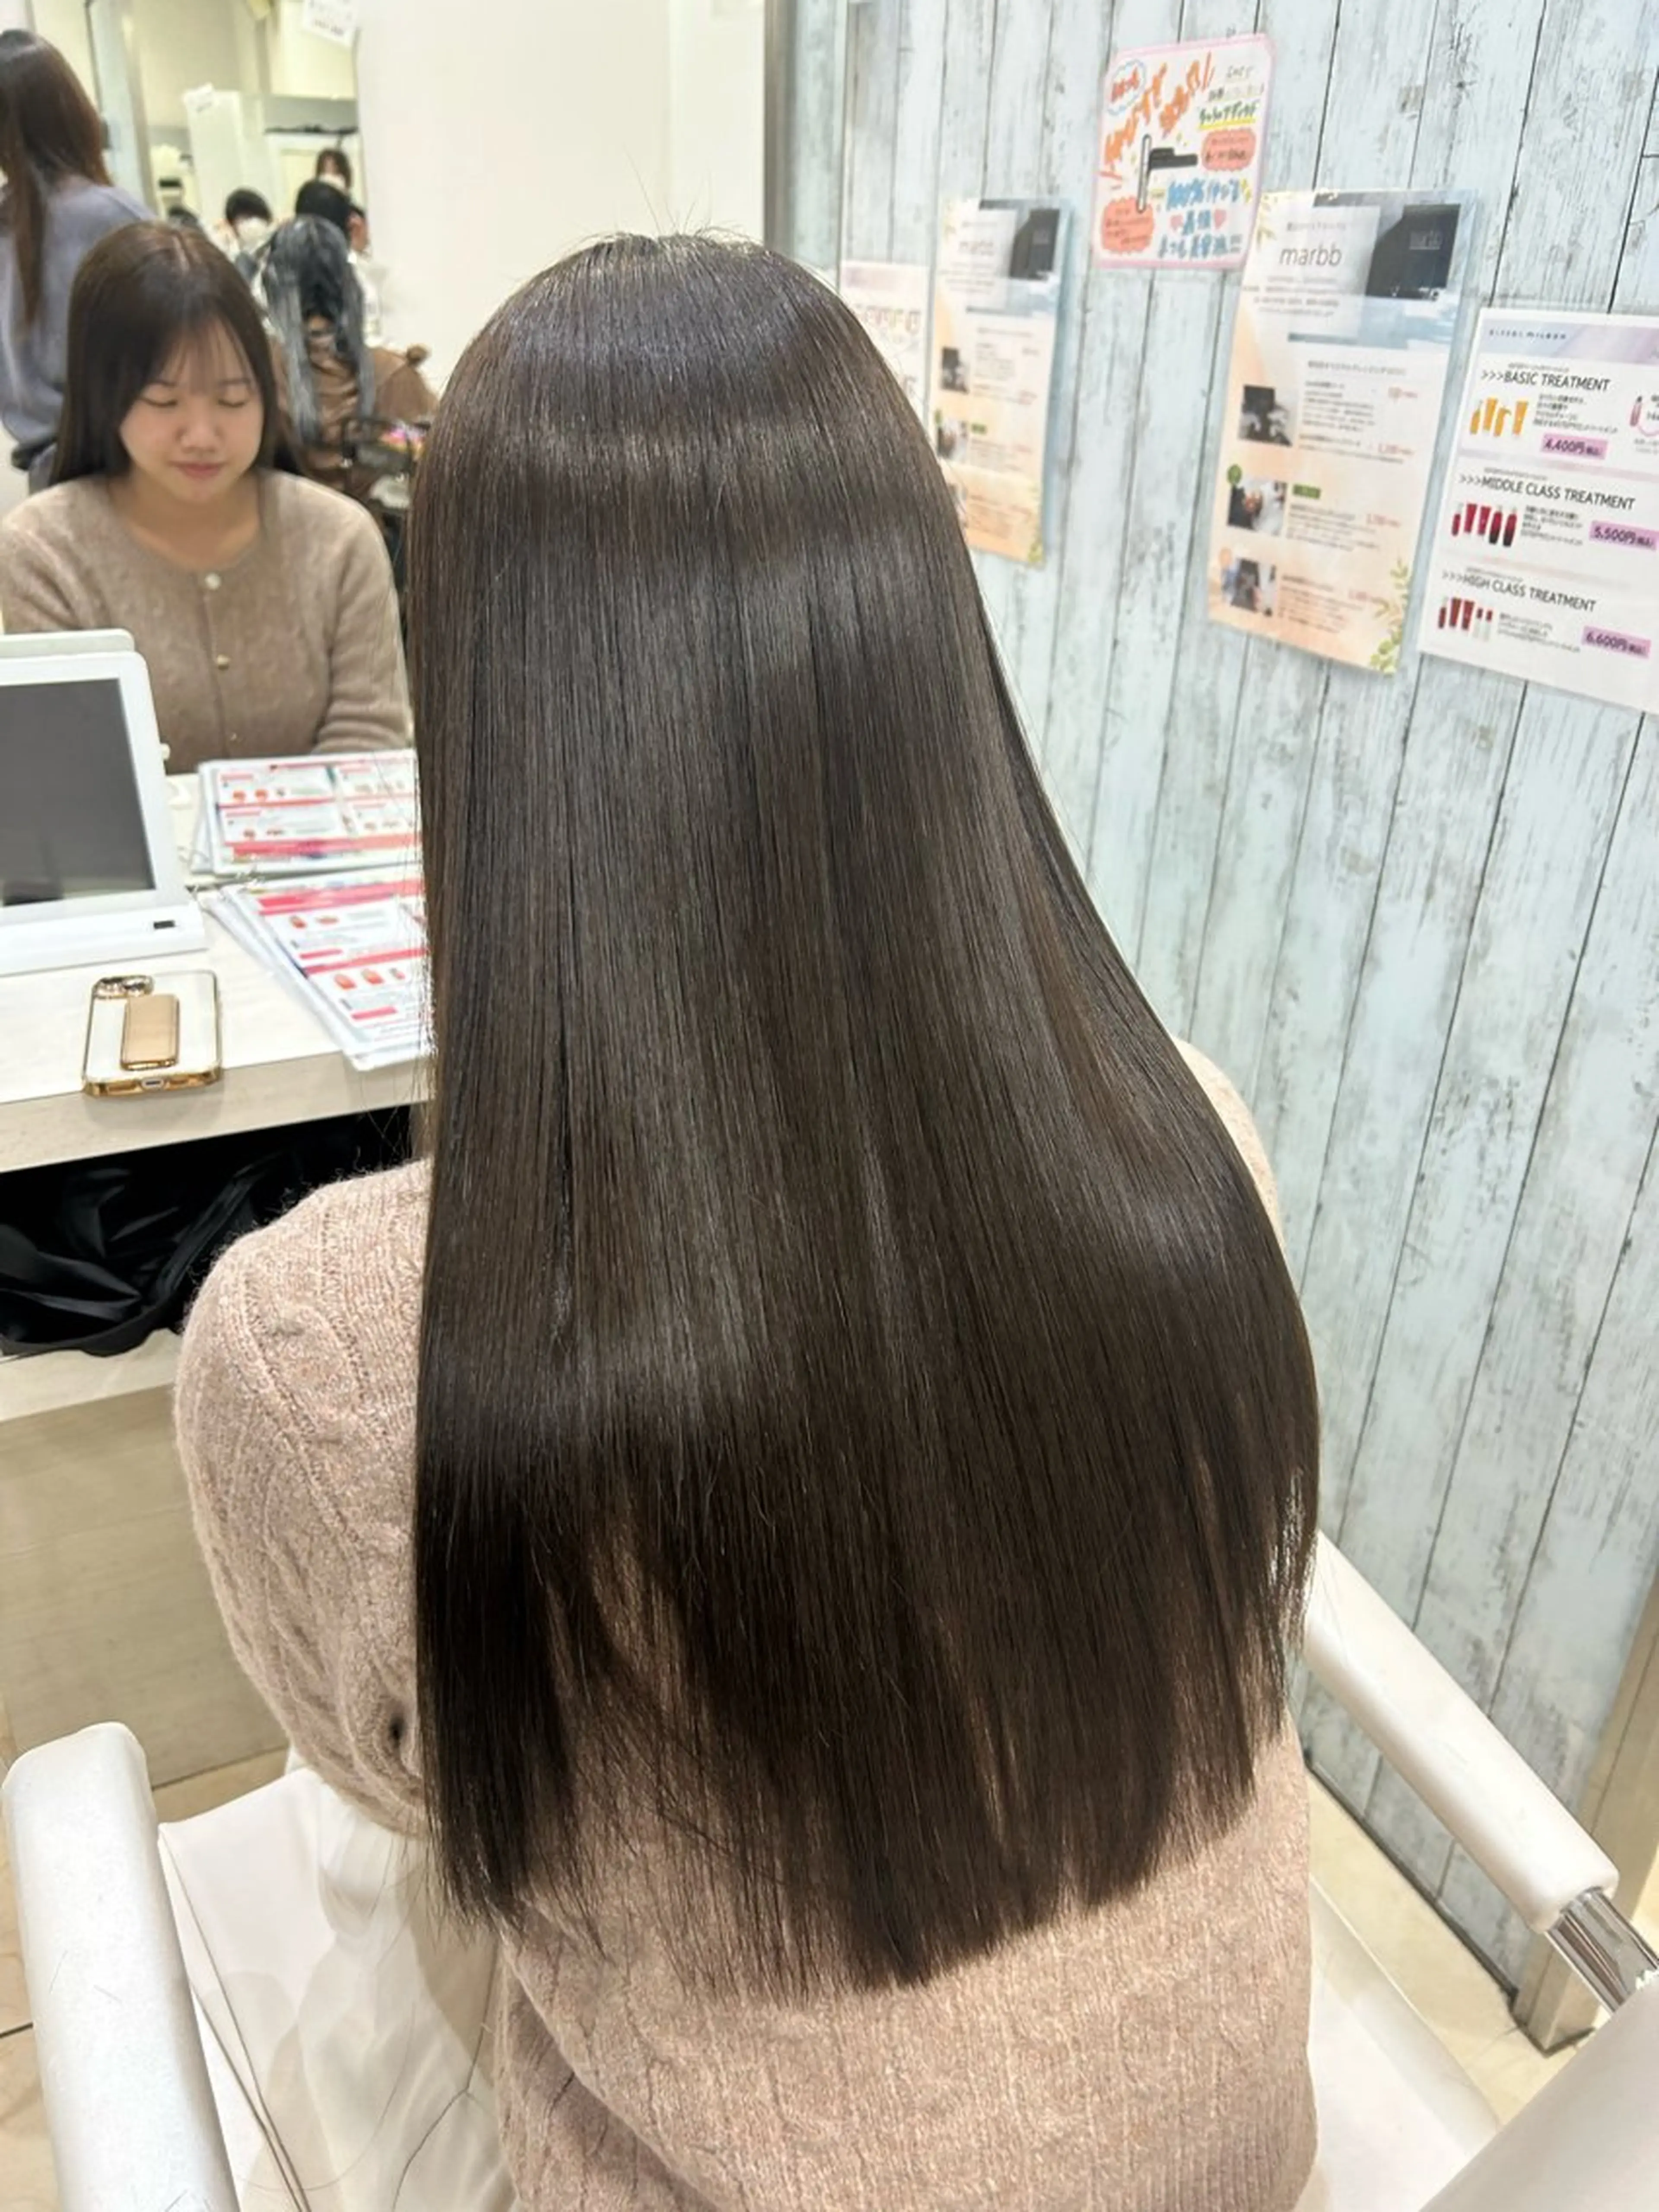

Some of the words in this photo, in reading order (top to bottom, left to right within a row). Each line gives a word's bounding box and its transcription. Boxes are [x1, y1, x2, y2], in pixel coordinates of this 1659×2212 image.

[1279, 241, 1342, 267] marbb
[1504, 370, 1538, 385] BASIC
[1541, 373, 1611, 391] TREATMENT
[1481, 477, 1523, 493] MIDDLE
[1526, 483, 1560, 499] CLASS
[1564, 488, 1636, 510] TREATMENT
[1463, 575, 1490, 590] HIGH
[1492, 579, 1526, 598] CLASS
[1529, 587, 1596, 613] TREATMENT
